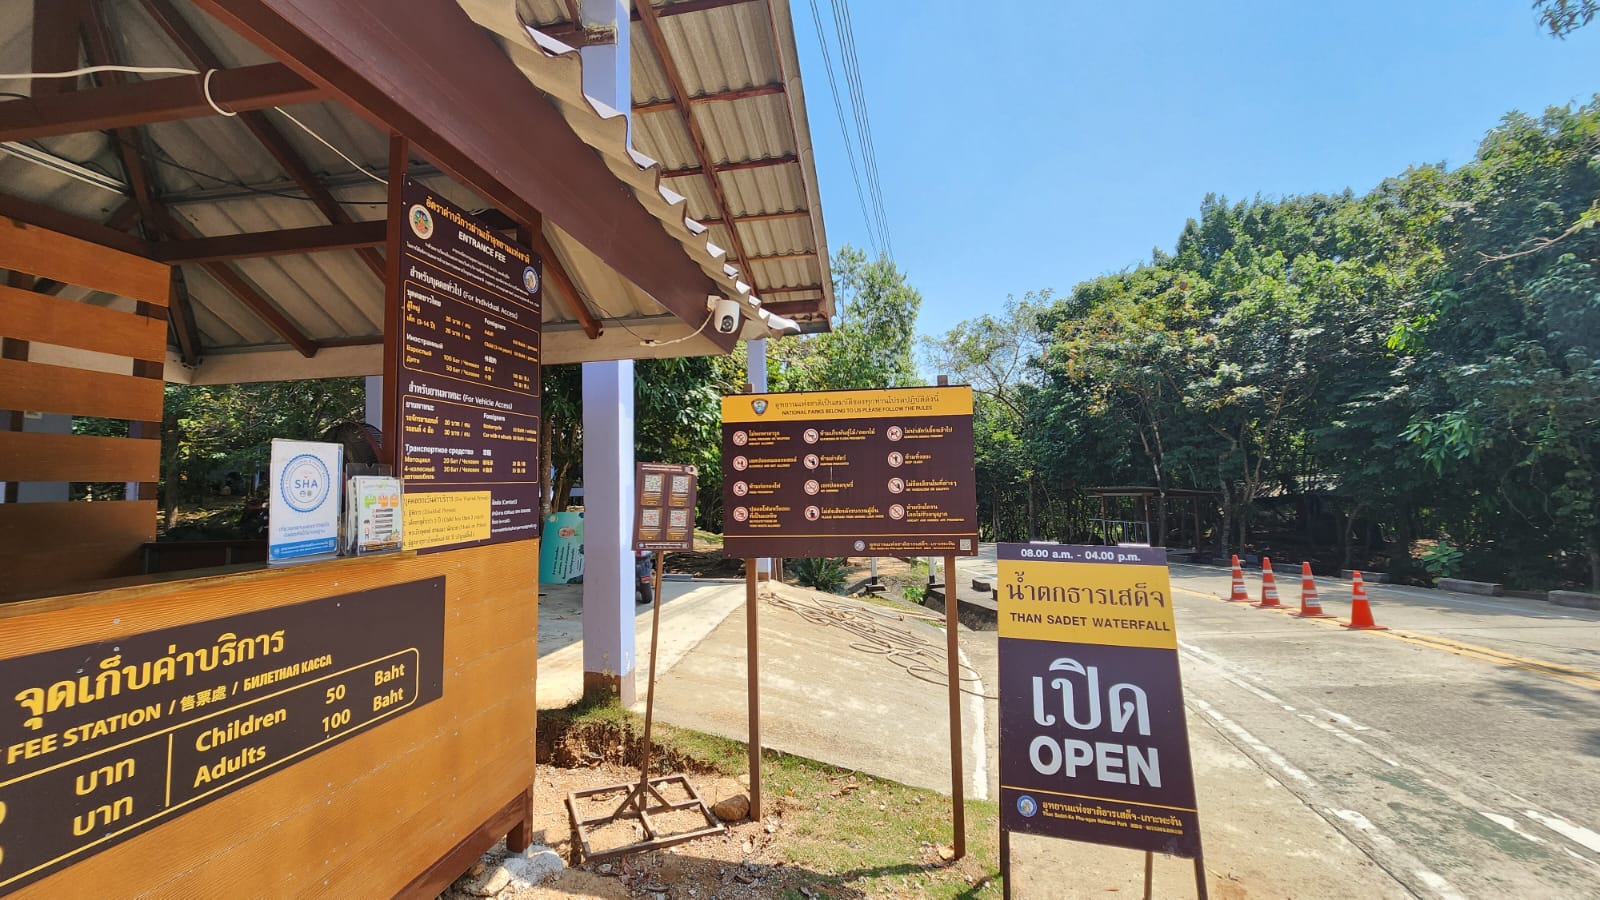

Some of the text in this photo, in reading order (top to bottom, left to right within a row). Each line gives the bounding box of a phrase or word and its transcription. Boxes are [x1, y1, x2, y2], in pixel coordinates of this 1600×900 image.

[459, 232, 507, 264] ENTRANCE FEE
[476, 295, 500, 312] Individual
[463, 394, 474, 402] (For
[476, 396, 494, 406] Vehicle
[495, 402, 512, 410] Access)
[294, 480, 318, 488] SHA
[1021, 548, 1048, 558] 08.00
[1085, 551, 1114, 560] 04.00
[1118, 554, 1141, 562] p.m.
[1006, 572, 1165, 608] น้ำตกธารเสด็จ
[1010, 612, 1170, 631] THAN SADET WATERFALL
[15, 629, 285, 731] จุดเก็บค่าบริการ
[1032, 657, 1151, 736] เปิด
[8, 654, 332, 764] FEE STATION / 售票處 / БИЛЕТНАЯ КАССА
[194, 663, 405, 752] Children 50 Baht
[193, 688, 404, 788] Adults 100 Baht
[75, 758, 136, 796] บาท
[1029, 735, 1162, 788] OPEN
[73, 796, 133, 837] บาท
[1097, 818, 1116, 826] National
